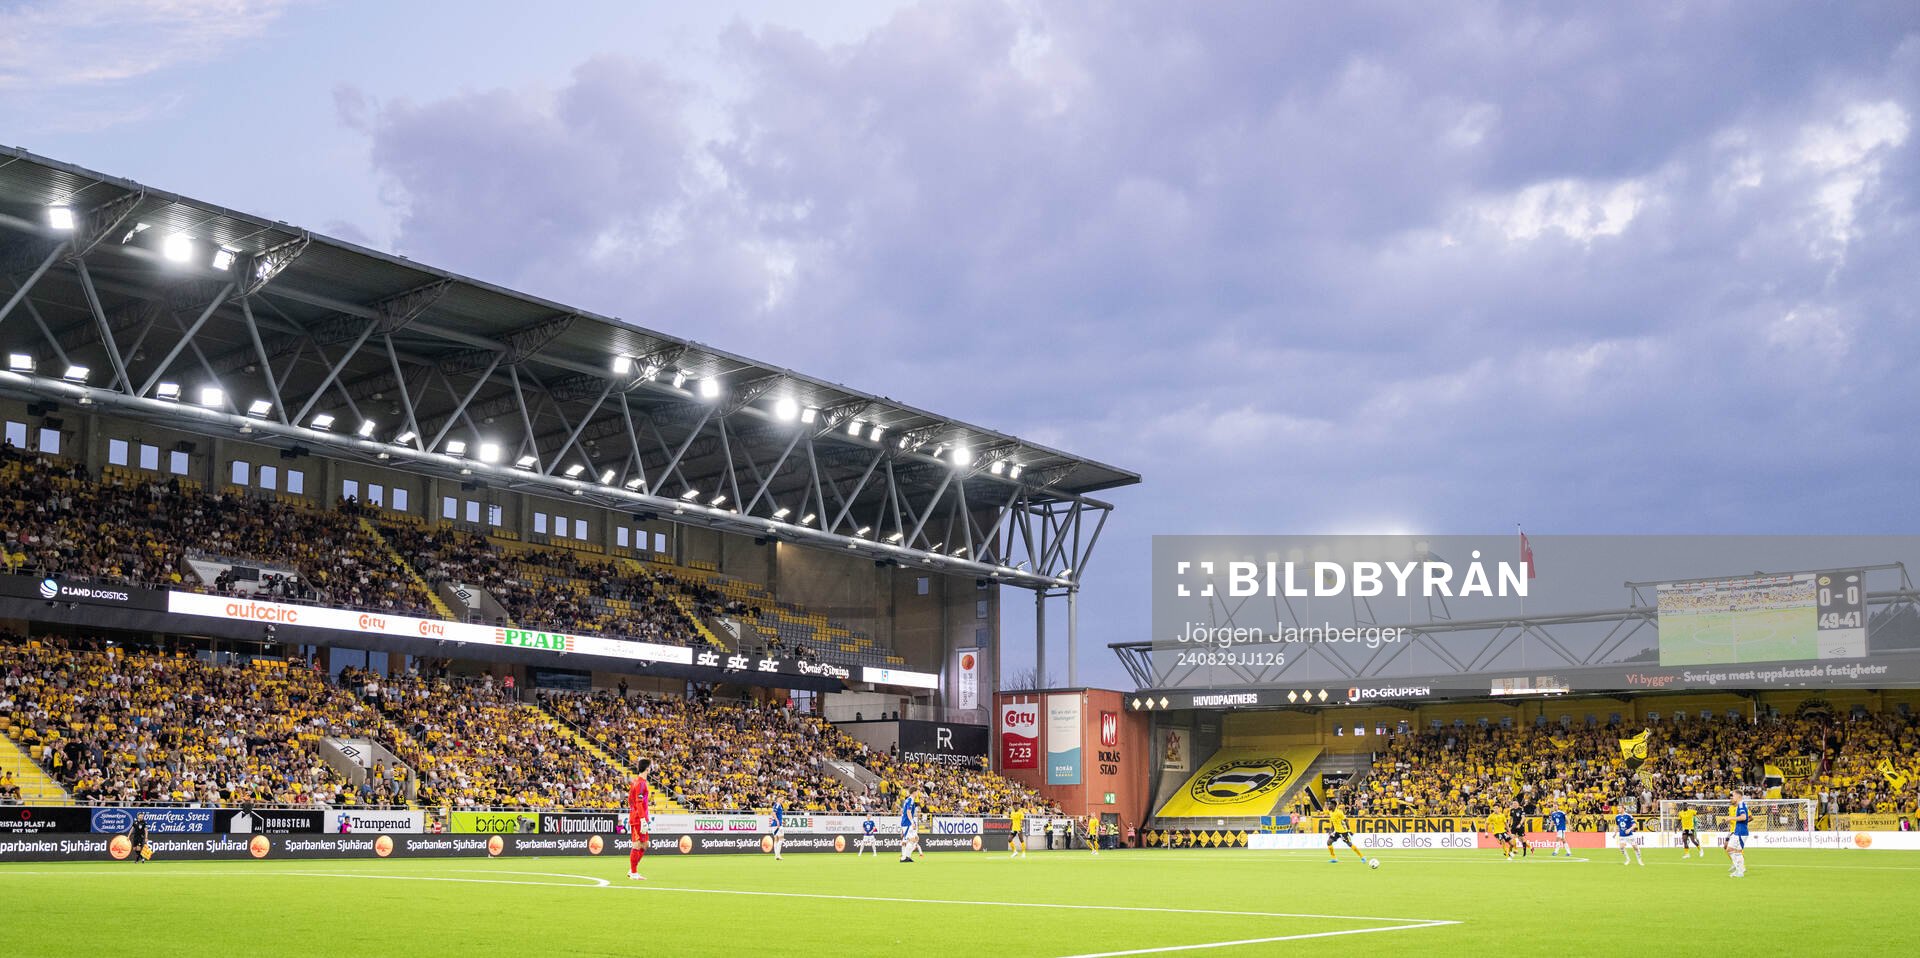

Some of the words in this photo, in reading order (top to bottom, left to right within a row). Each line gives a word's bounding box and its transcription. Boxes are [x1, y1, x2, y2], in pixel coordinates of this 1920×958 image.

[61, 587, 68, 595] C
[69, 588, 91, 597] LAND
[91, 590, 128, 601] LOGISTICS
[1819, 588, 1831, 606] 0
[1847, 586, 1858, 605] 0
[226, 601, 298, 622] autocirc
[504, 629, 565, 651] PEAB
[697, 651, 720, 667] stc
[726, 653, 749, 669] stc
[758, 657, 779, 673] stc
[1626, 674, 1638, 684] Vi
[1640, 674, 1674, 687] bygger
[1684, 670, 1727, 685] Sveriges
[1729, 670, 1755, 680] mest
[1757, 666, 1824, 684] uppskattade
[1826, 663, 1888, 679] fastigheter
[1362, 686, 1430, 699] RO-GRUPPEN
[1193, 693, 1258, 707] HUVUDPARTNERS
[1005, 710, 1036, 727] City
[904, 751, 979, 766] FASTIGHETSSERVIC
[1008, 748, 1032, 759] 7-23
[1098, 750, 1121, 763] BORÅS
[1100, 764, 1118, 775] STAD
[135, 811, 184, 823] ömarkens
[185, 811, 210, 822] Svets
[266, 818, 311, 828] BORGSTENA
[353, 817, 411, 831] Tranpenad
[781, 818, 808, 828] EAB
[145, 822, 157, 832] ch
[159, 822, 186, 832] Smide
[187, 822, 203, 832] AB
[544, 816, 614, 834] Skyltproduktion
[695, 821, 723, 830] VISKO
[730, 821, 757, 830] VISKO
[939, 820, 978, 834] Nordea
[285, 840, 336, 852] Sparbanken
[337, 839, 374, 852] Sjuhärad
[406, 839, 452, 851] Sparbanken
[453, 839, 487, 851] Sjuhärad
[516, 839, 557, 850] Sparbanken
[558, 839, 588, 850] Sjuhärad
[614, 839, 651, 849] Sparbn
[652, 839, 679, 850] Sjuhärad
[701, 839, 736, 849] Sparbanken
[737, 838, 761, 849] Sjuhärad
[782, 839, 812, 848] Sparbanken
[813, 838, 834, 848] Sjuhärad
[925, 838, 953, 847] Sparbanken
[1364, 833, 1394, 848] ellos
[1402, 833, 1432, 848] ellos
[1441, 833, 1472, 848] ellos
[1764, 835, 1812, 844] Sparbanken
[1814, 834, 1852, 844] Sjuhärad
[0, 840, 58, 854] parbanken
[60, 839, 108, 854] Sjuhärad
[146, 840, 204, 854] Sparbanken
[206, 839, 248, 853] Sjuhärad
